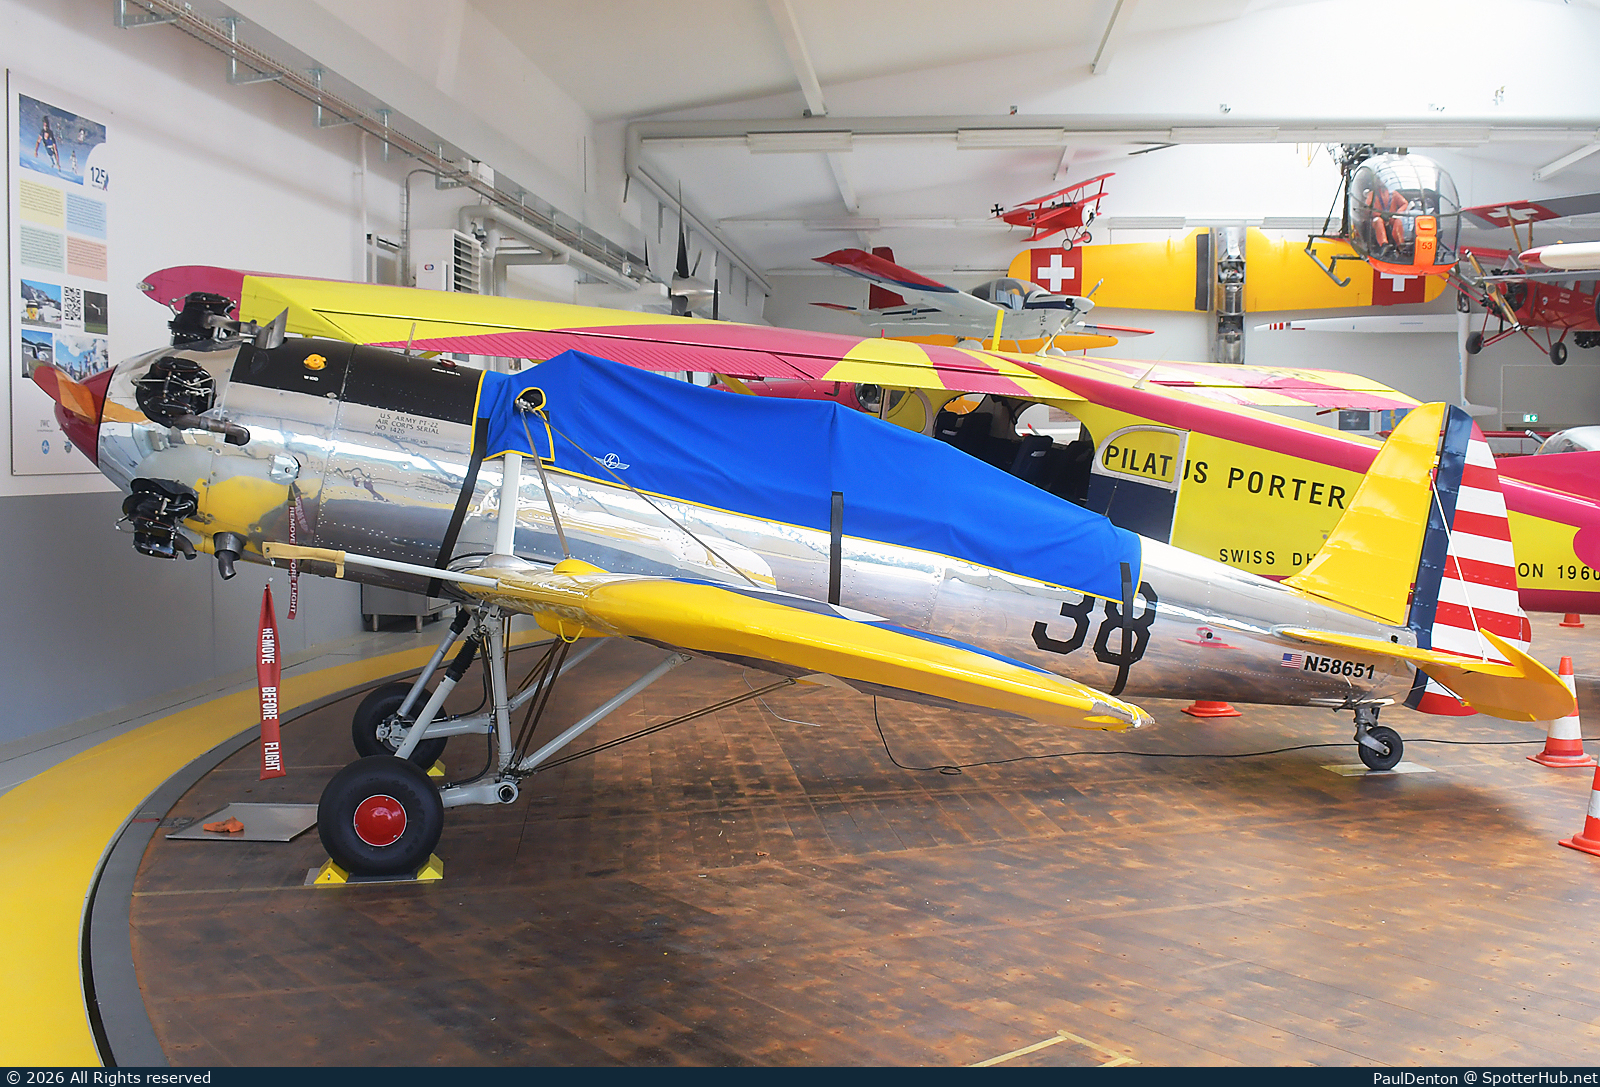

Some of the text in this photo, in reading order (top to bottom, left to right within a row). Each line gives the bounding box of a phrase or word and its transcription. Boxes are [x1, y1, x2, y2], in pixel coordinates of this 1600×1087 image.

[1422, 242, 1432, 250] 53
[376, 418, 440, 435] AIR CORPS SERIAL
[395, 416, 417, 424] ARMY
[1228, 467, 1345, 509] PORTER
[1219, 548, 1275, 565] SWISS
[1517, 562, 1600, 581] ON 1960
[1031, 580, 1158, 666] 38
[1303, 655, 1375, 680] N58651
[261, 627, 281, 771] REMOVE BEFORE FLIGHT
